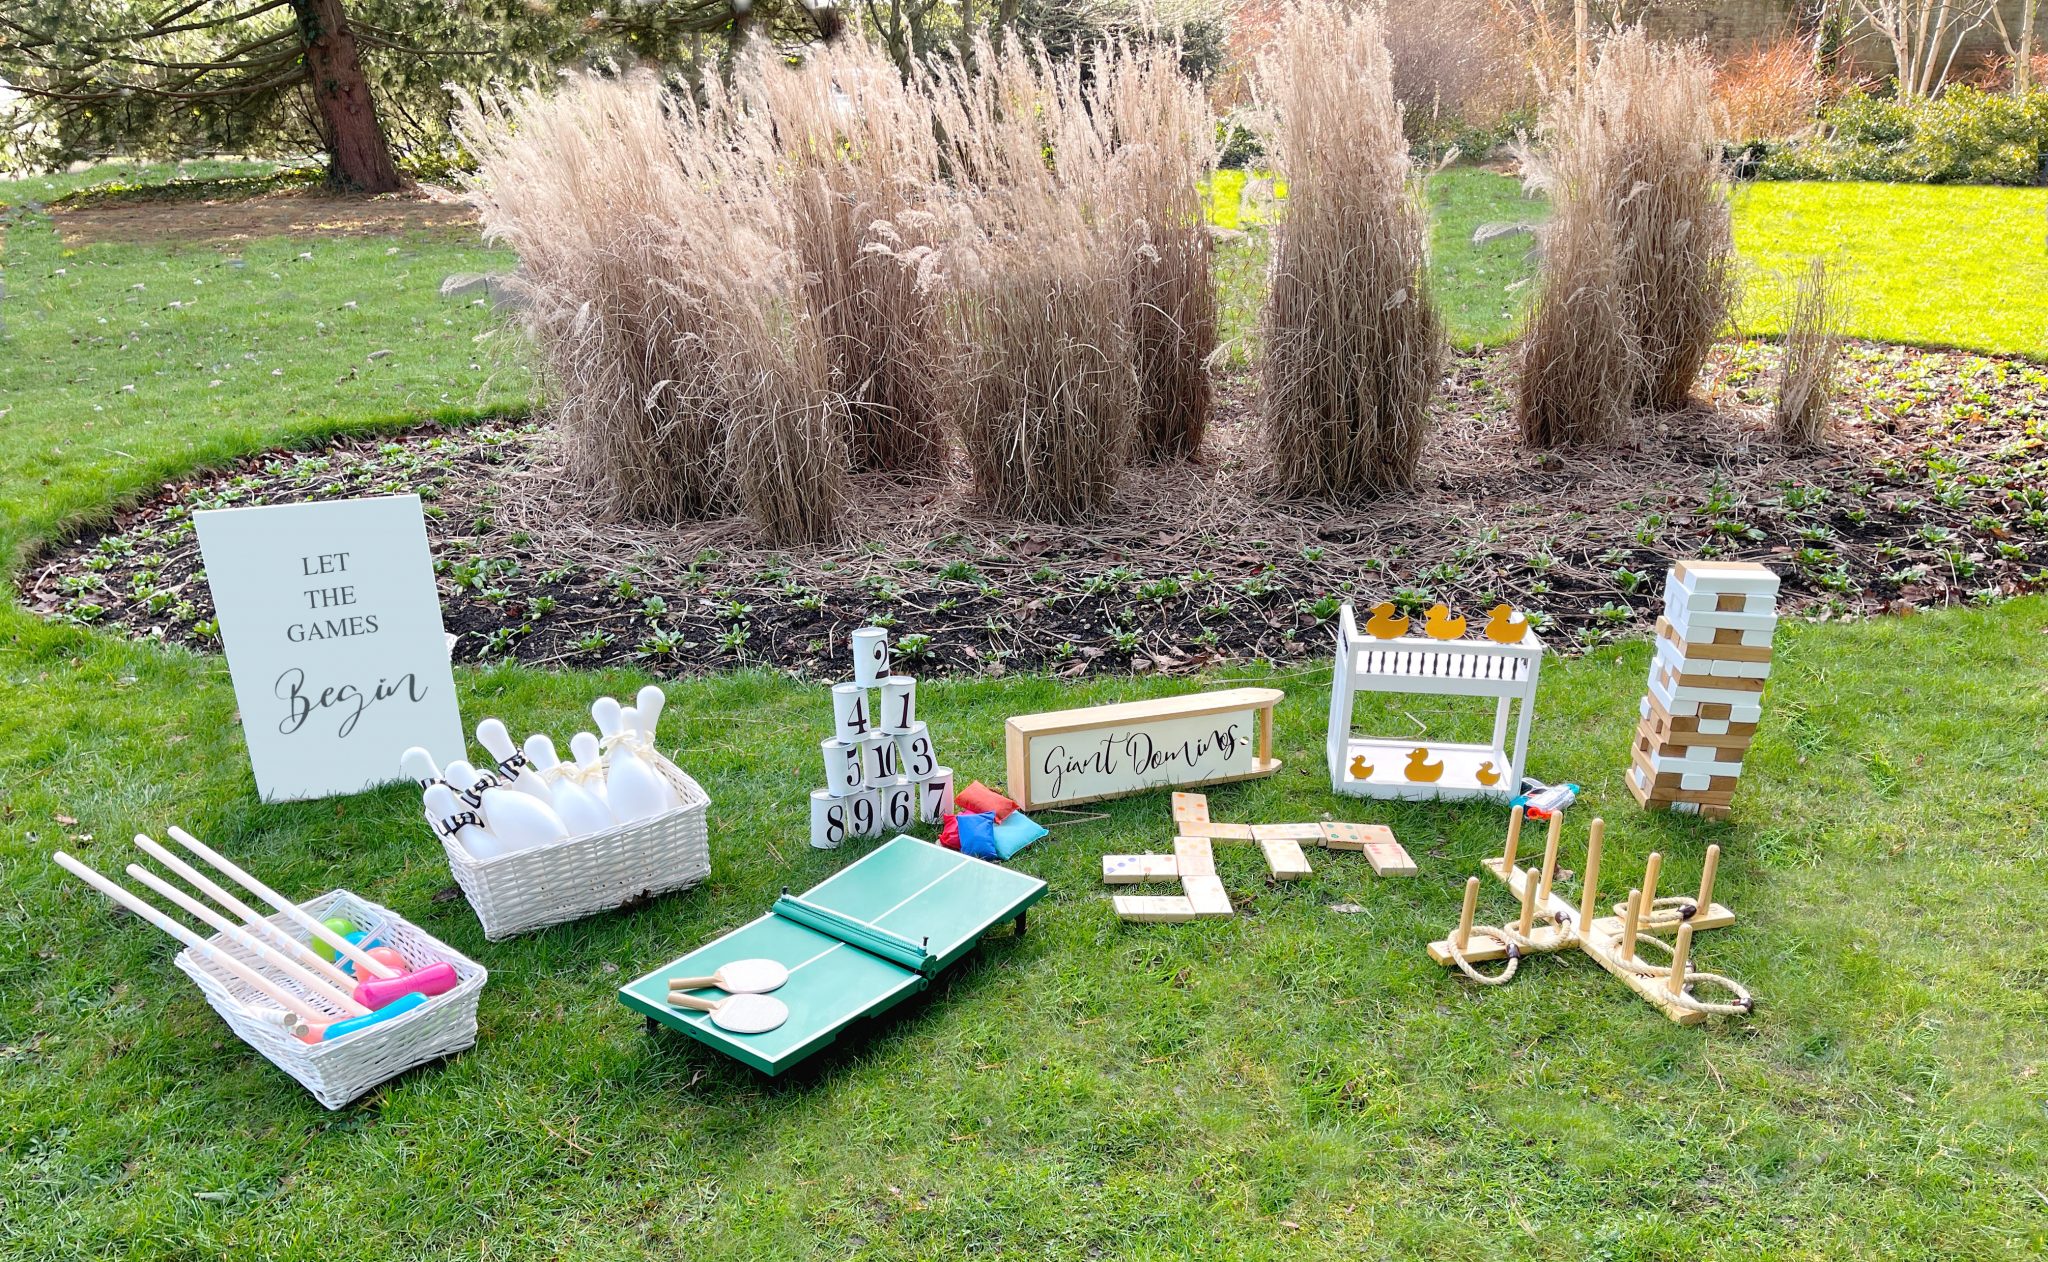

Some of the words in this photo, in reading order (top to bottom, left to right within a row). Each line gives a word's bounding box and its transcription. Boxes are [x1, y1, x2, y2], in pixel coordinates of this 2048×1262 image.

[302, 552, 350, 576] LET
[304, 586, 357, 609] THE
[286, 615, 379, 643] GAMES
[873, 640, 889, 680] 2
[274, 667, 429, 738] Begin
[847, 697, 867, 735] 4
[896, 692, 910, 729] 1
[846, 748, 861, 787] 5
[871, 741, 898, 779] 10
[912, 737, 933, 776] 3
[1044, 732, 1130, 799] Giant
[1126, 724, 1238, 775] Dominos
[853, 798, 874, 836] 9
[890, 790, 910, 828] 6
[928, 782, 946, 822] 7
[826, 805, 845, 844] 8
